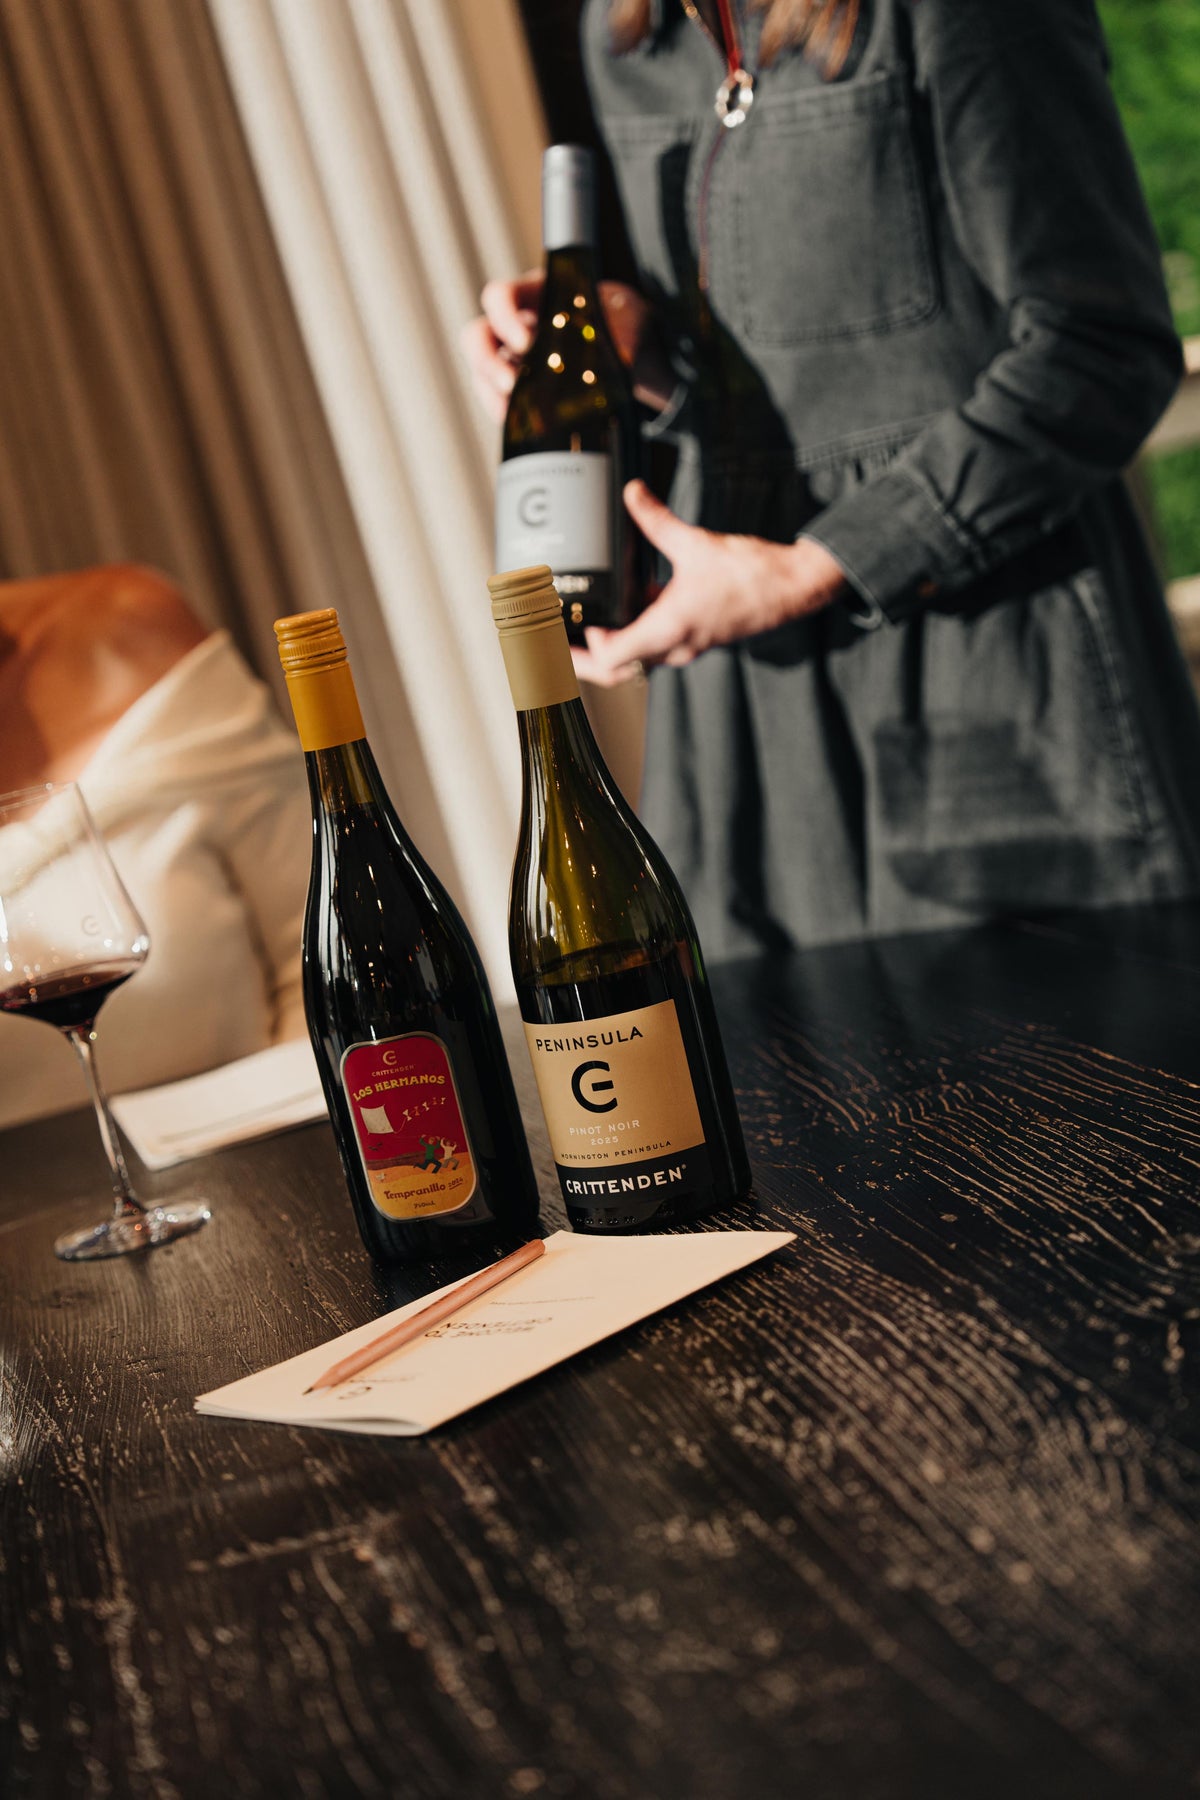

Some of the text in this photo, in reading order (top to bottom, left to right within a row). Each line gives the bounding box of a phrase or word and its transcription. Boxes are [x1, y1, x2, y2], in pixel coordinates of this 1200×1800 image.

[535, 1026, 644, 1052] PENINSULA
[371, 1064, 415, 1077] CRITTENDEN
[353, 1074, 446, 1101] LOS HERMANOS
[569, 1119, 641, 1136] PINOT NOIR
[561, 1140, 672, 1160] MORNINGTON PENINSULA
[591, 1136, 619, 1146] 2025
[383, 1182, 446, 1200] Tempranillo
